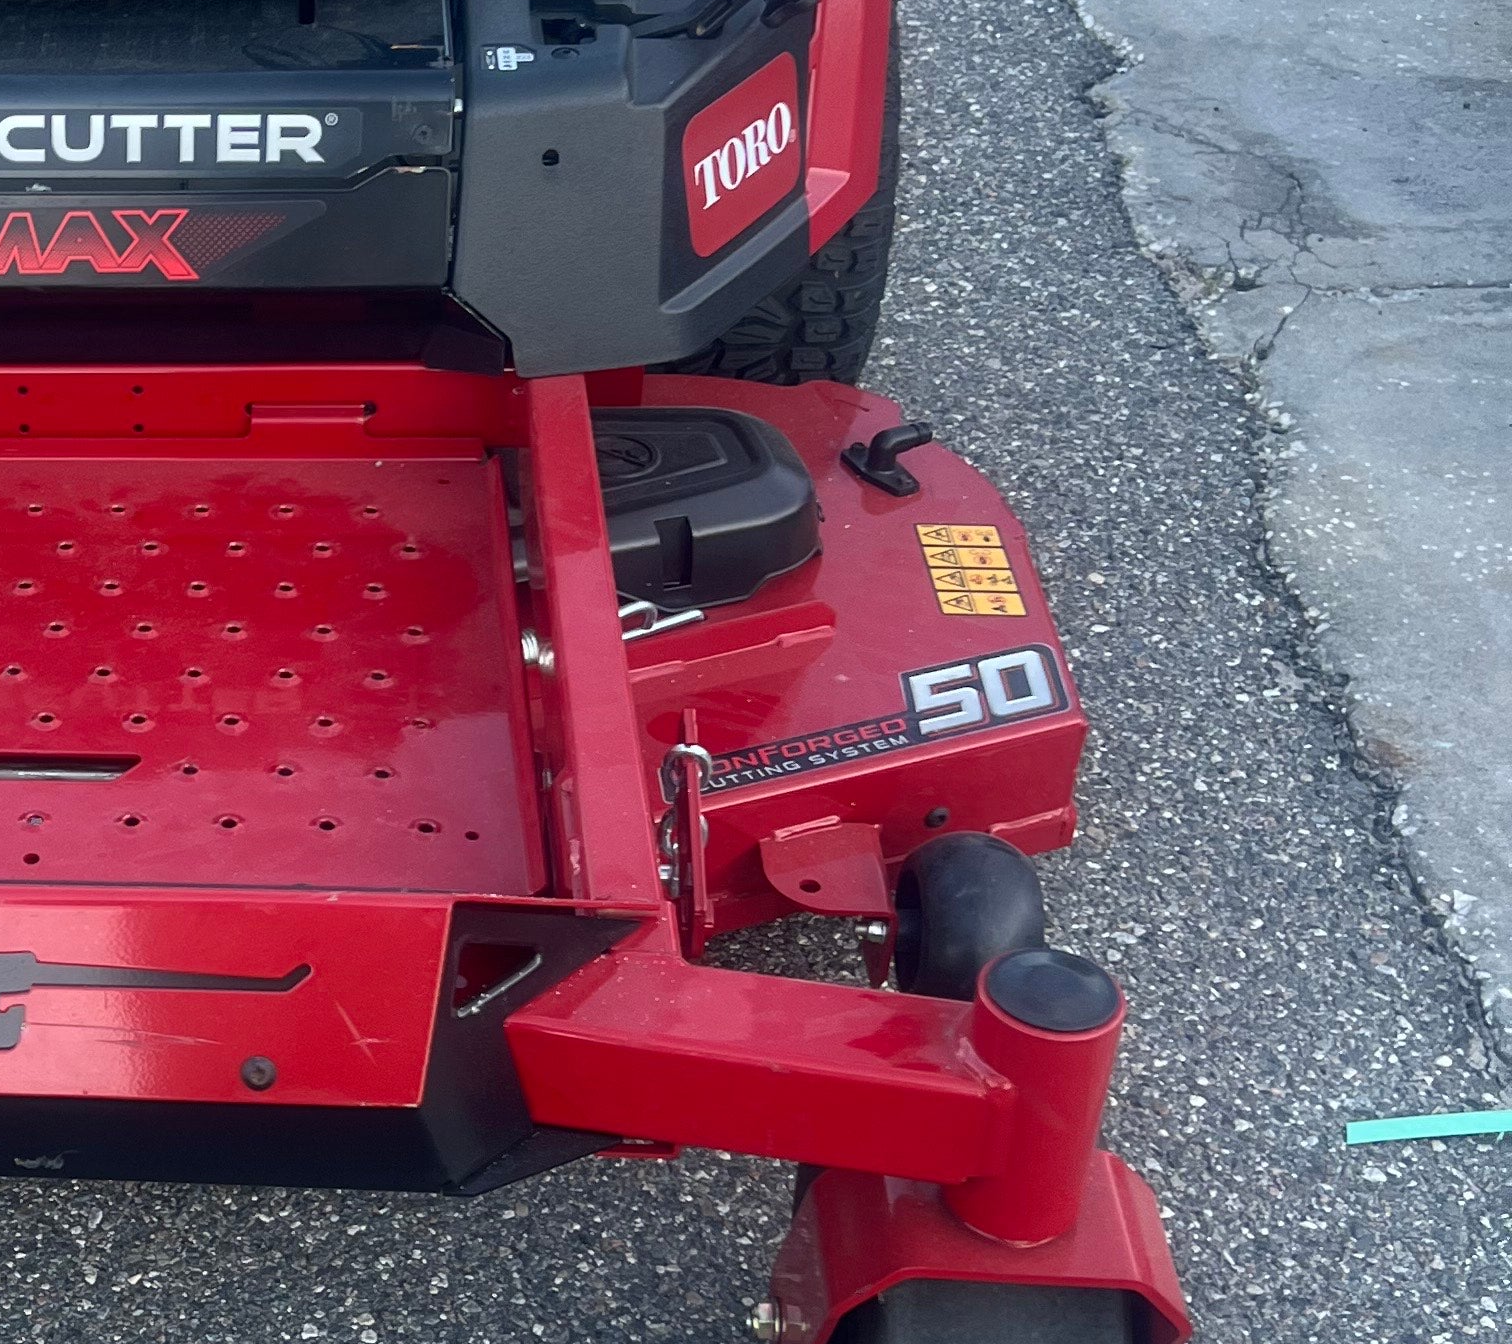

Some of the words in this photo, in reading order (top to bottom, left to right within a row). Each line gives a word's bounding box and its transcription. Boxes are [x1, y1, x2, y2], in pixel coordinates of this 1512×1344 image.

[694, 102, 792, 210] TORO
[908, 649, 1054, 736] 50
[700, 760, 802, 792] UTTING
[808, 734, 910, 766] SYSTEM
